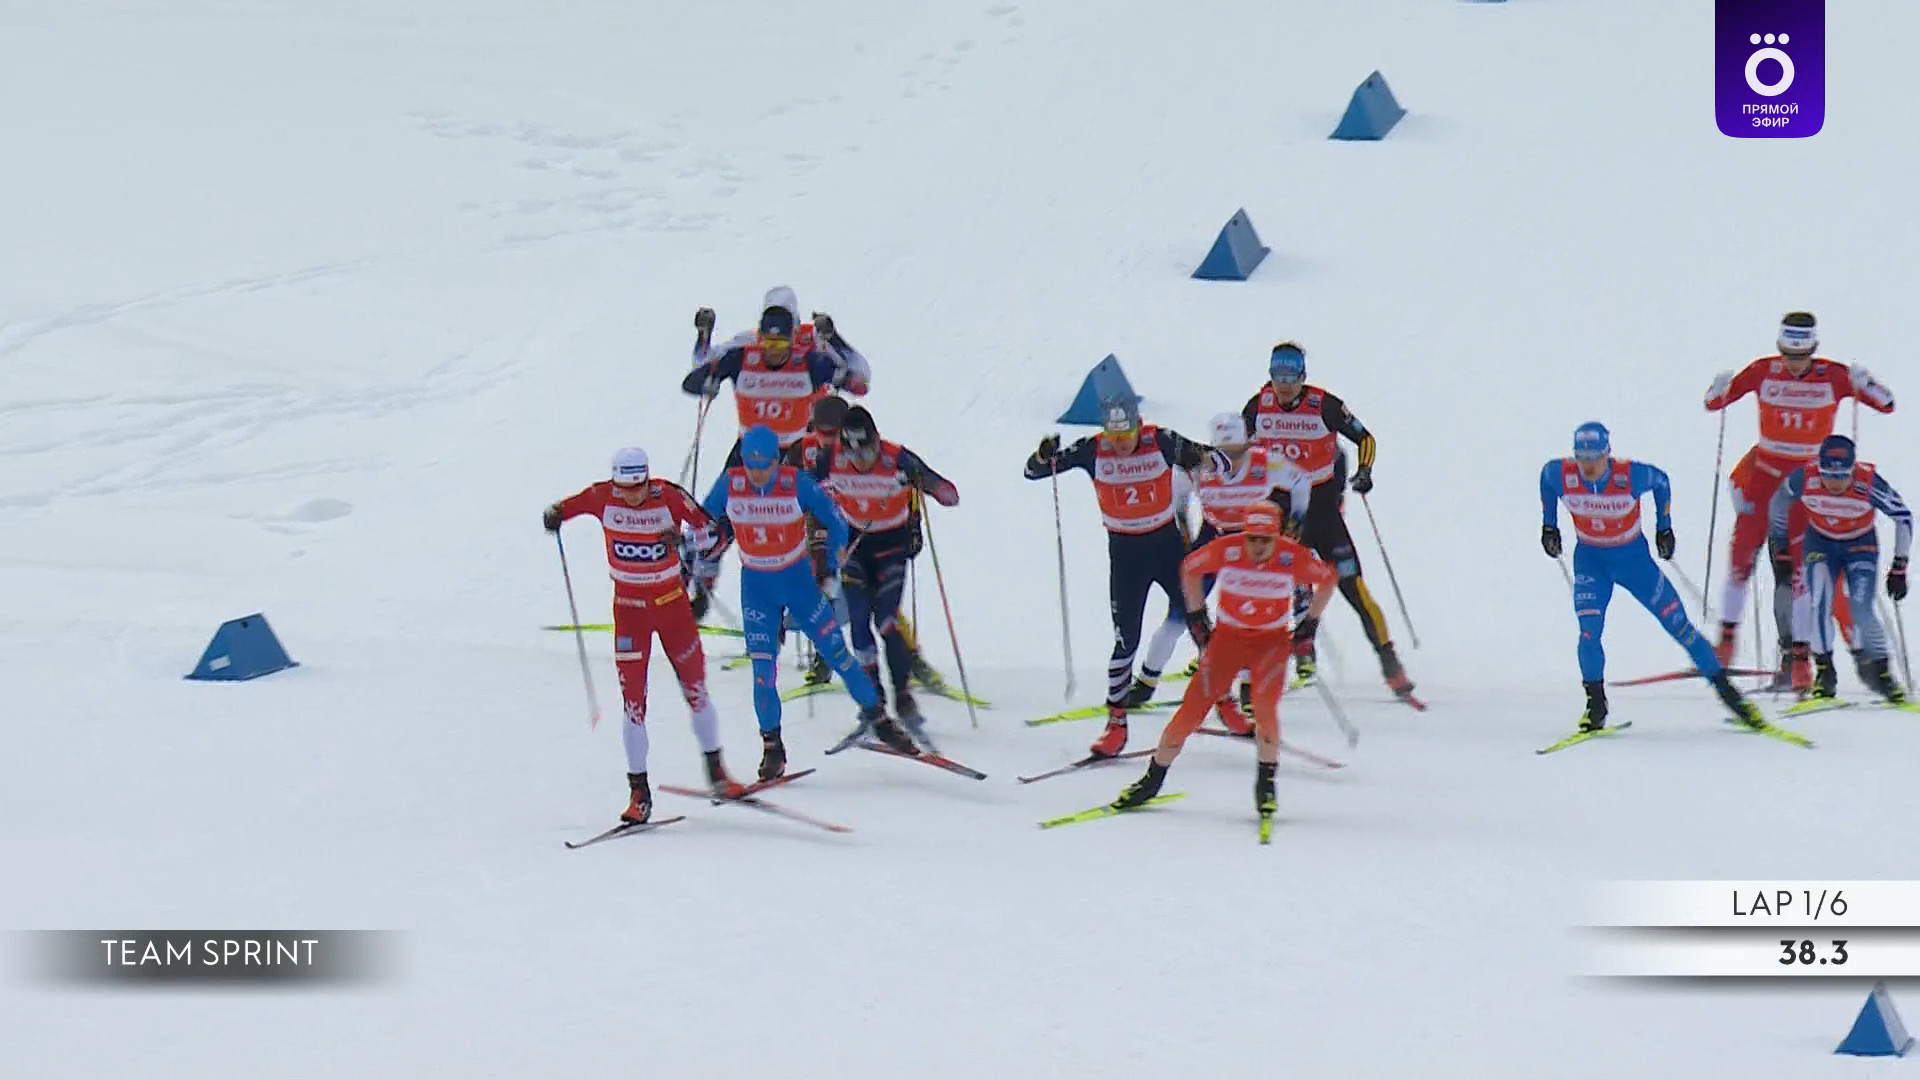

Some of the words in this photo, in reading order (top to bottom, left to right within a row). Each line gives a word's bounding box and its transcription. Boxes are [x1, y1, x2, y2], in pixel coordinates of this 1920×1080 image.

[757, 401, 782, 419] 10
[1275, 418, 1318, 431] Sunrise
[1780, 411, 1803, 429] 11
[1117, 461, 1160, 475] Sunrise
[1124, 488, 1139, 505] 2
[748, 504, 794, 514] Sunrise
[1583, 500, 1629, 511] Sunrise
[753, 526, 767, 545] 3
[614, 543, 666, 561] coop
